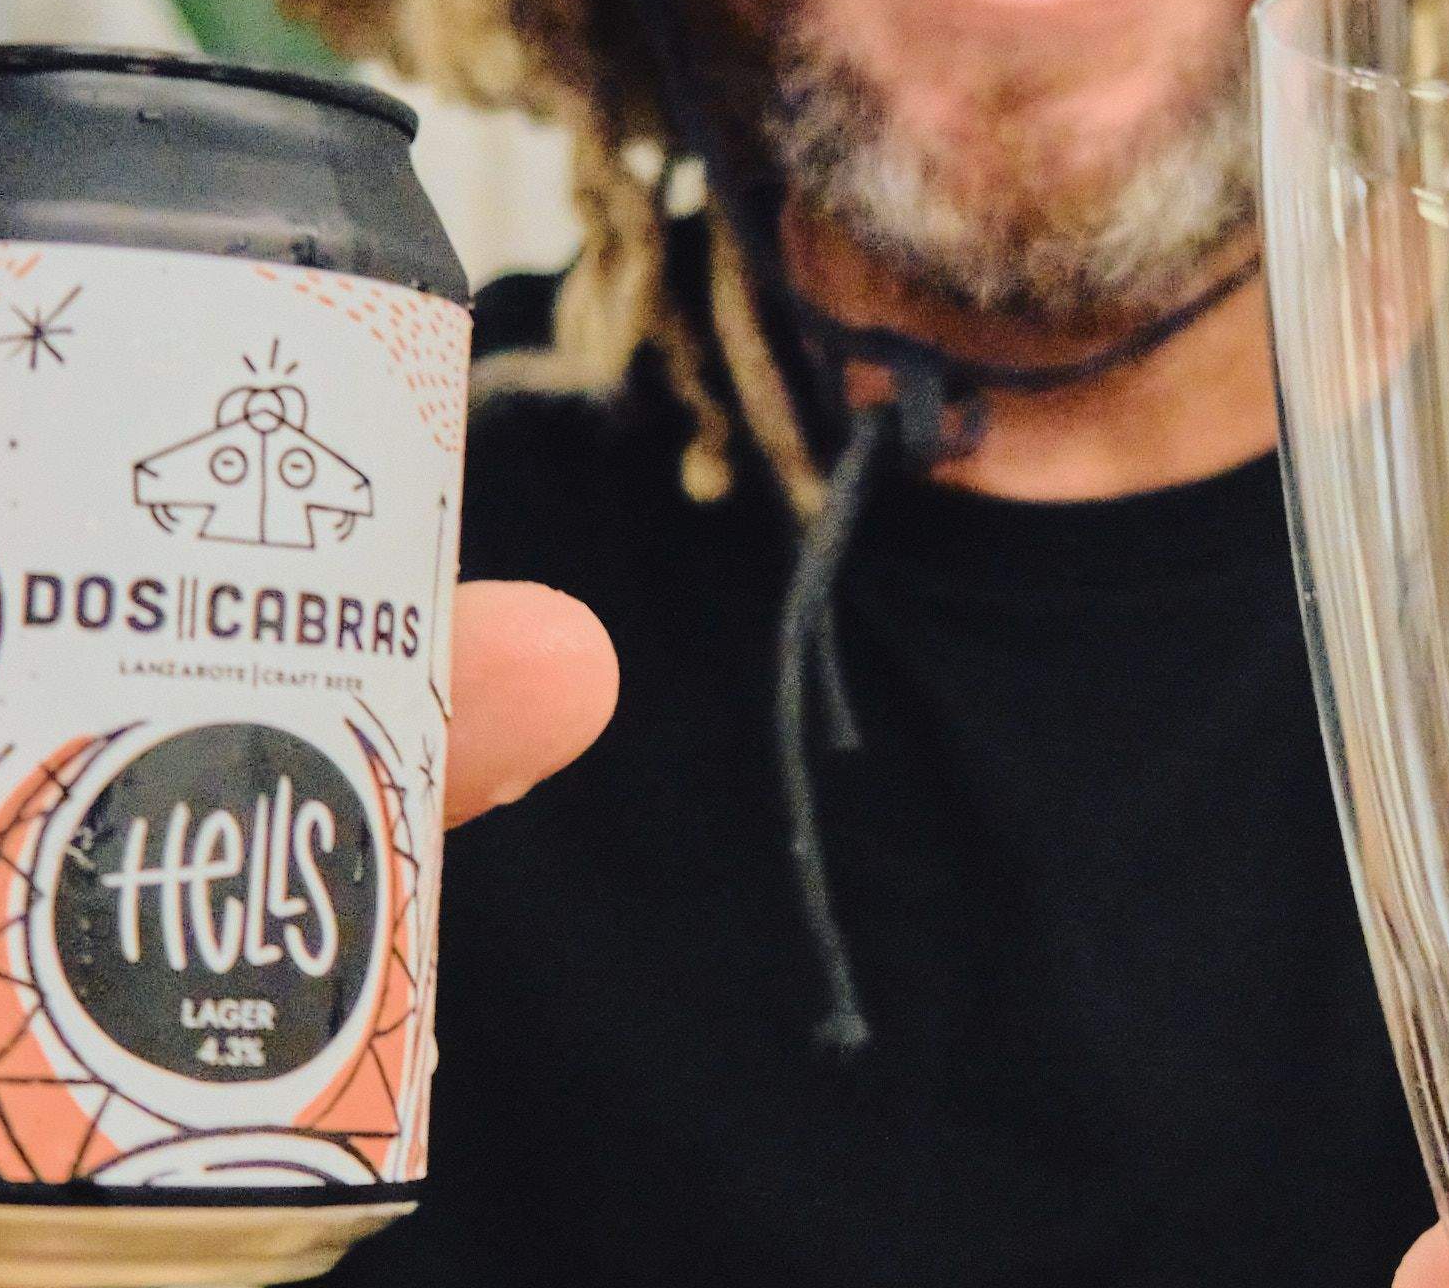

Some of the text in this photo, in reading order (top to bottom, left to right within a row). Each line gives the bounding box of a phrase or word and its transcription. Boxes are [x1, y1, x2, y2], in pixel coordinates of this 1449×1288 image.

[23, 572, 420, 659] DOS CABRAS
[118, 660, 364, 692] LANZAROTE CRAFT BEER
[180, 997, 278, 1030] LAGER
